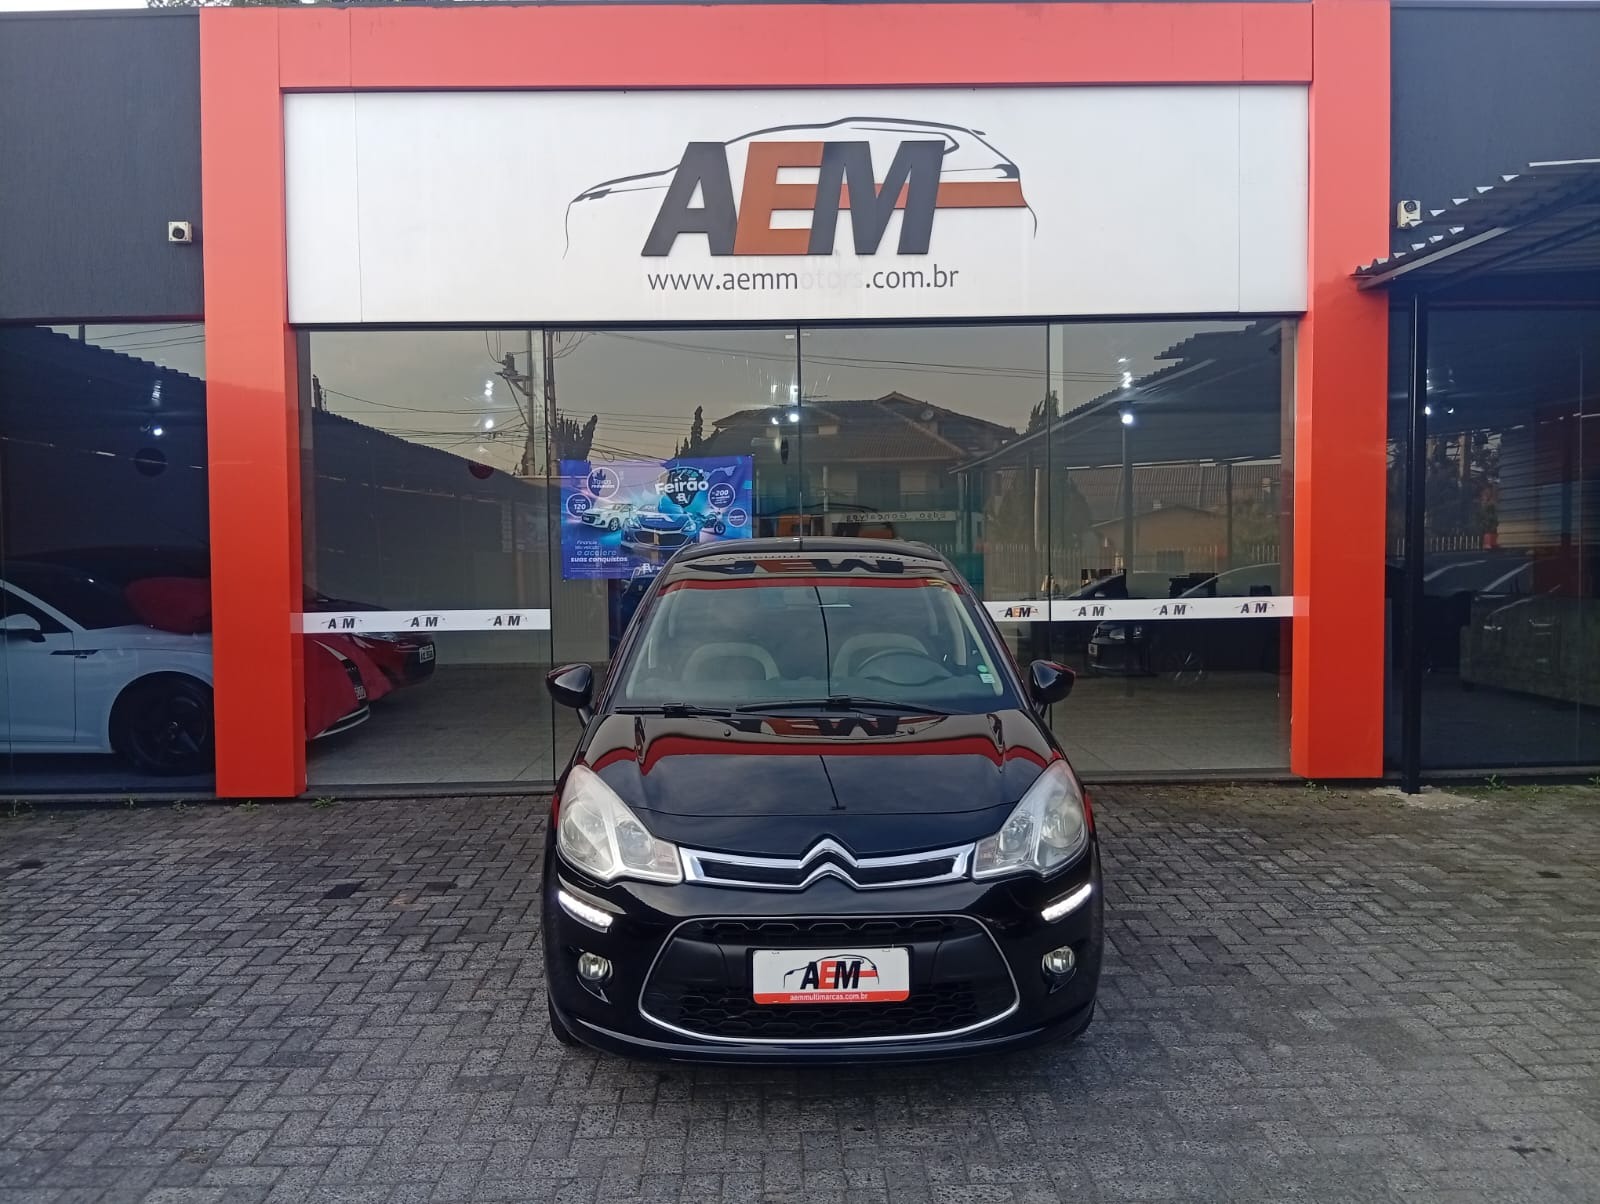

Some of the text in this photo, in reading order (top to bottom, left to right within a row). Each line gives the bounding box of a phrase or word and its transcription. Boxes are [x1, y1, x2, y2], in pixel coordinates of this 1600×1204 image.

[641, 140, 946, 257] AEM
[654, 477, 709, 495] Feirão
[588, 556, 628, 564] conquistas
[1004, 606, 1031, 618] AEM
[800, 960, 862, 990] AEM
[789, 992, 868, 1001] aemmultimarcas.com.br
